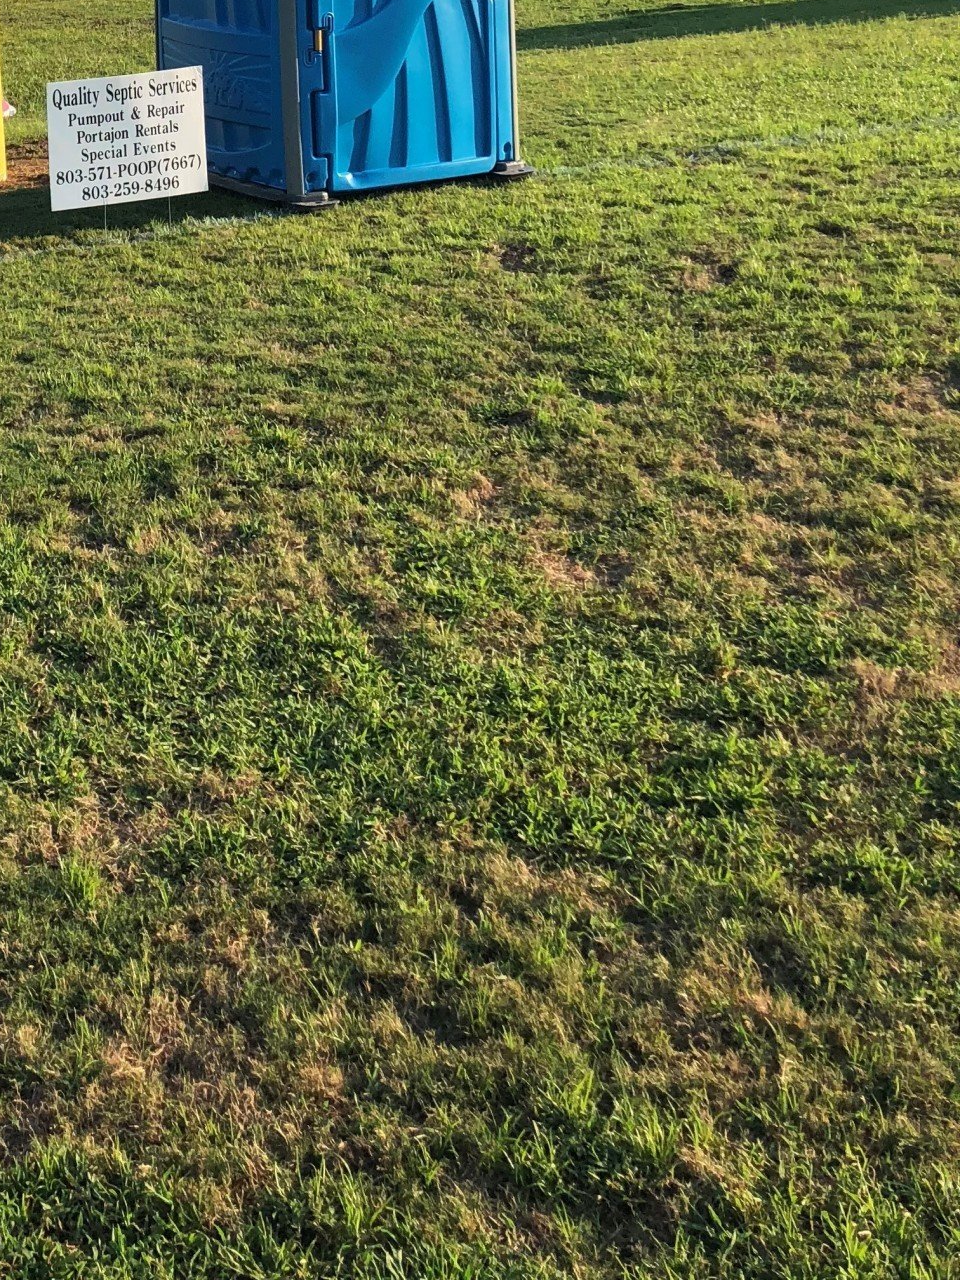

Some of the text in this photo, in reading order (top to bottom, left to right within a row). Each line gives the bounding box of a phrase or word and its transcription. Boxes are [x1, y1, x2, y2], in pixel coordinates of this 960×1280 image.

[52, 86, 99, 110] Quality
[105, 80, 143, 105] Septic
[148, 74, 197, 97] Services
[68, 100, 185, 127] Pumpout & Repair
[76, 120, 179, 145] Portajon Rentals
[81, 140, 177, 164] Special Events
[56, 153, 202, 186] 803-571-POOP(7667)
[82, 175, 180, 201] 803-259-8496
